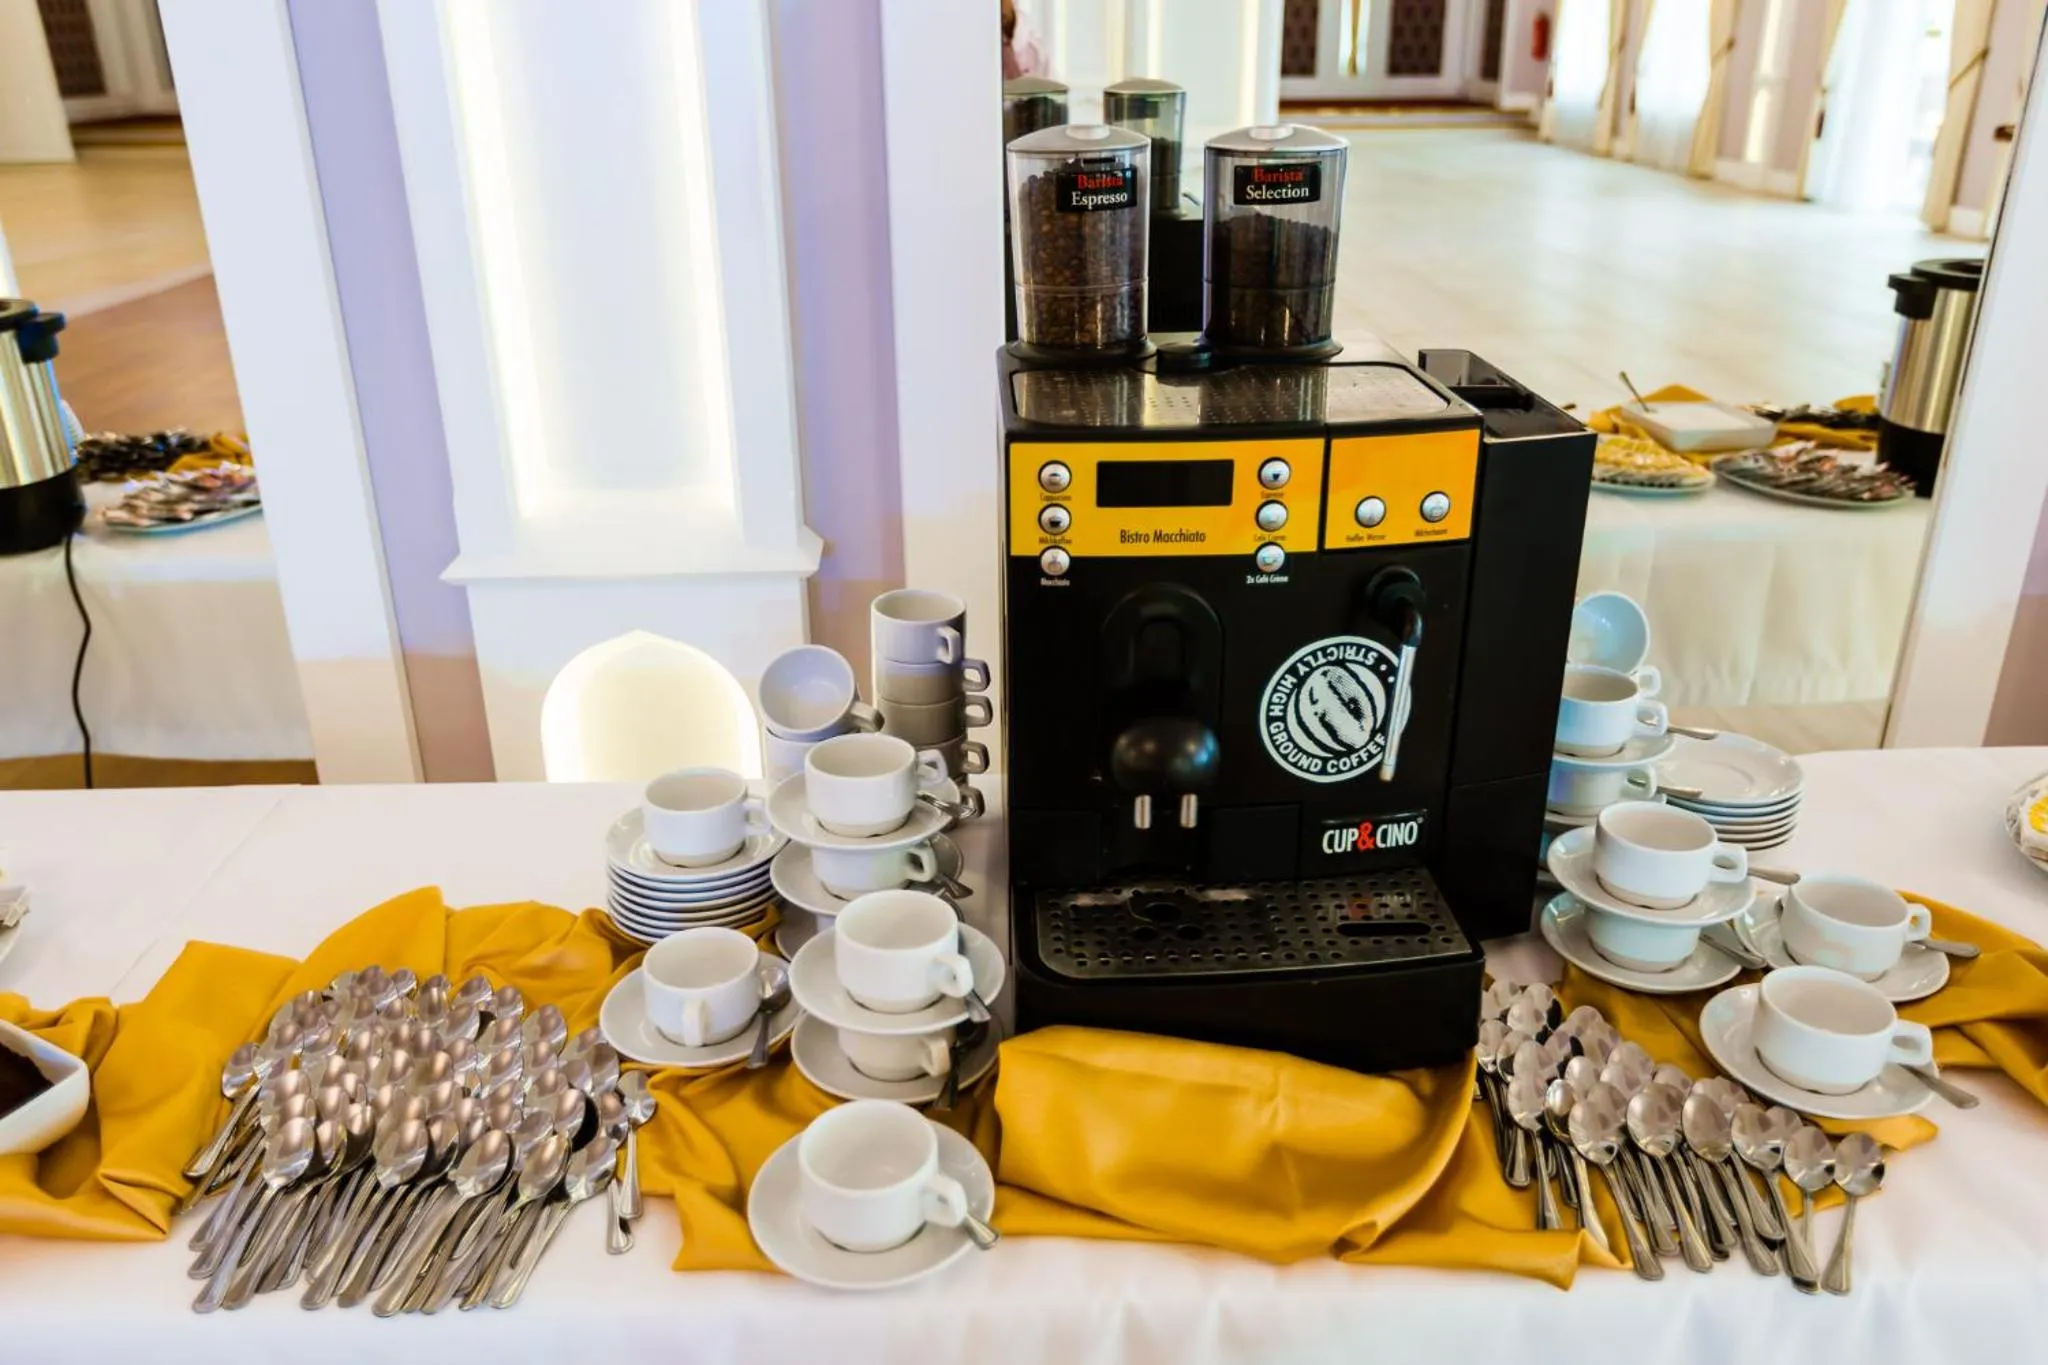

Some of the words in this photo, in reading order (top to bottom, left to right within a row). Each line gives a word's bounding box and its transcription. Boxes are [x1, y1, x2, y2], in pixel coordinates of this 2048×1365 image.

[1254, 167, 1304, 183] Barista
[1071, 190, 1128, 211] Espresso
[1246, 183, 1310, 200] Selection
[1119, 528, 1150, 545] Bistro
[1153, 527, 1207, 544] Macchiato
[1295, 645, 1379, 677] STRICTLY
[1269, 673, 1298, 717] HIGH
[1269, 721, 1323, 773] GROUND
